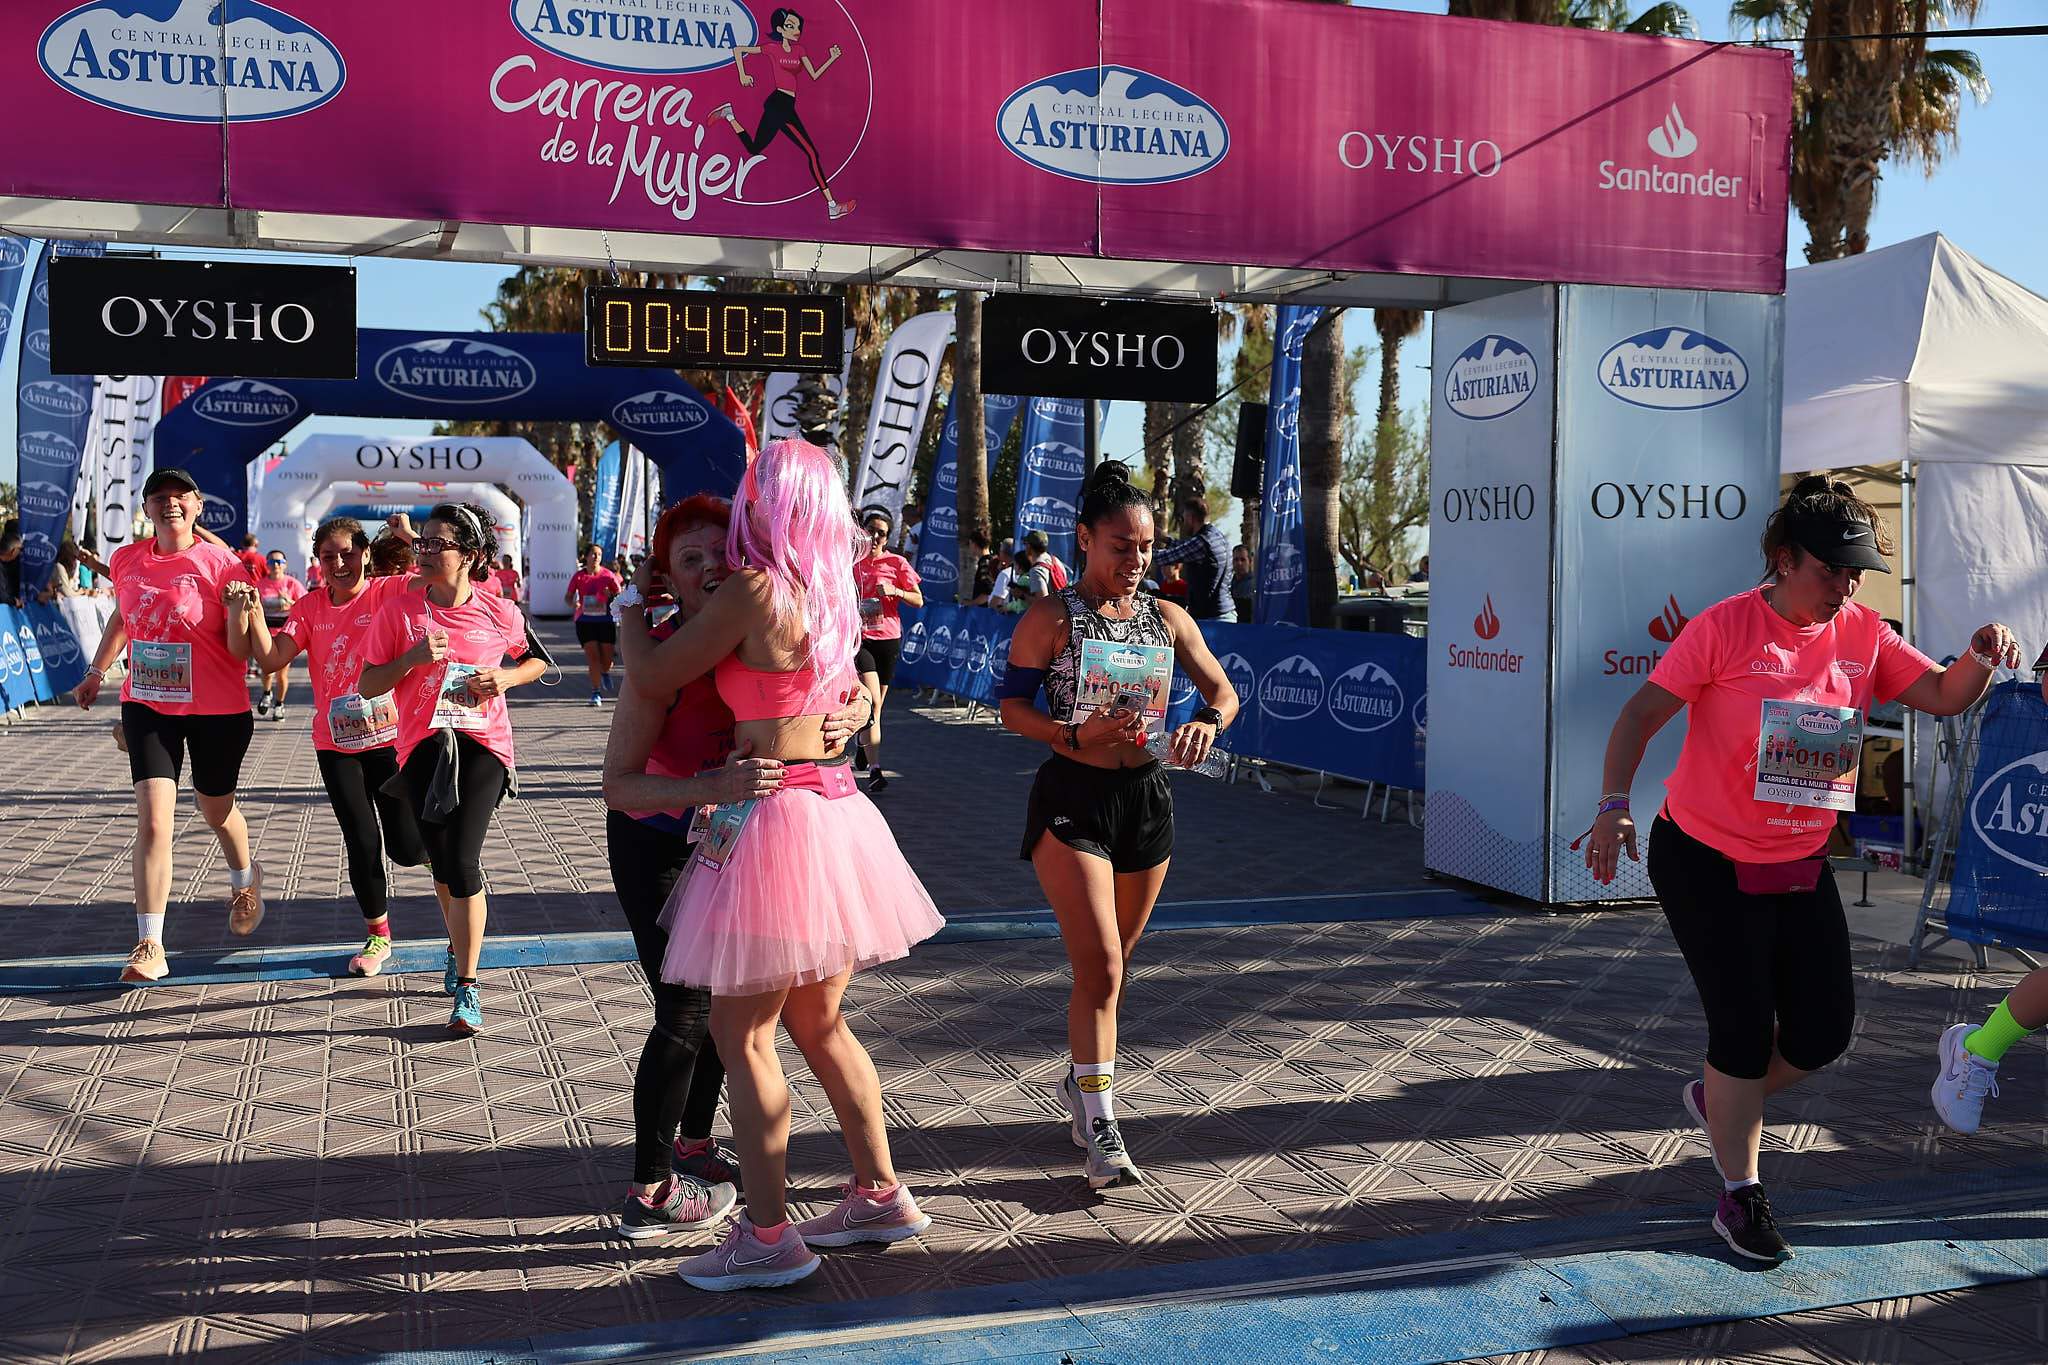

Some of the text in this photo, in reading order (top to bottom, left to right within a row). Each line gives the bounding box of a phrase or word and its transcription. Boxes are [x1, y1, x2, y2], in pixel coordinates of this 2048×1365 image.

[111, 28, 208, 47] CENTRAL
[530, 0, 739, 50] ASTURIANA
[63, 28, 324, 94] ASTURIANA
[489, 54, 694, 129] Carrera
[1052, 102, 1205, 124] CENTRAL LECHERA
[1015, 102, 1212, 159] ASTURIANA
[1337, 131, 1503, 178] OYSHO
[540, 122, 767, 222] de la Mujer
[1599, 160, 1743, 198] Santander
[101, 296, 316, 344] OYSHO
[605, 300, 825, 358] 00:40:32
[1021, 327, 1185, 370] OYSHO
[1632, 354, 1734, 366] CENTRAL LECHERA
[388, 357, 525, 390] ASTURIANA
[1464, 359, 1528, 376] CENTRAL LECHERA
[1608, 355, 1738, 390] ASTURIANA
[1450, 370, 1531, 402] ASTURIANA
[199, 395, 290, 417] ASTURIANA
[618, 408, 705, 425] ASTURIANA
[1037, 397, 1085, 418] ASTURIA
[356, 444, 483, 471] OYSHO
[1029, 449, 1085, 475] ASTURIAN
[278, 471, 318, 481] OYSHO
[518, 473, 555, 482] OYSHO
[1443, 483, 1535, 523] OYSHO
[1590, 481, 1747, 521] OYSHO
[261, 521, 299, 530] OYSHO
[537, 523, 573, 532] OYSHO
[536, 572, 572, 581] OYSHO
[1448, 643, 1524, 674] Santander
[1751, 660, 1797, 675] OYSHO
[1262, 677, 1319, 706] ASTURIANA
[1332, 684, 1394, 718] ASTURIANA
[1800, 717, 1840, 731] ASTURIANA
[1795, 748, 1836, 769] 016
[1763, 774, 1790, 785] CARRERA
[1791, 777, 1799, 786] DE
[1801, 778, 1808, 786] LA
[1808, 780, 1828, 789] MUJER
[1805, 770, 1820, 778] 317
[1767, 787, 1802, 799] OYSHO
[1766, 817, 1792, 827] CARRERA
[1792, 819, 1799, 827] DE
